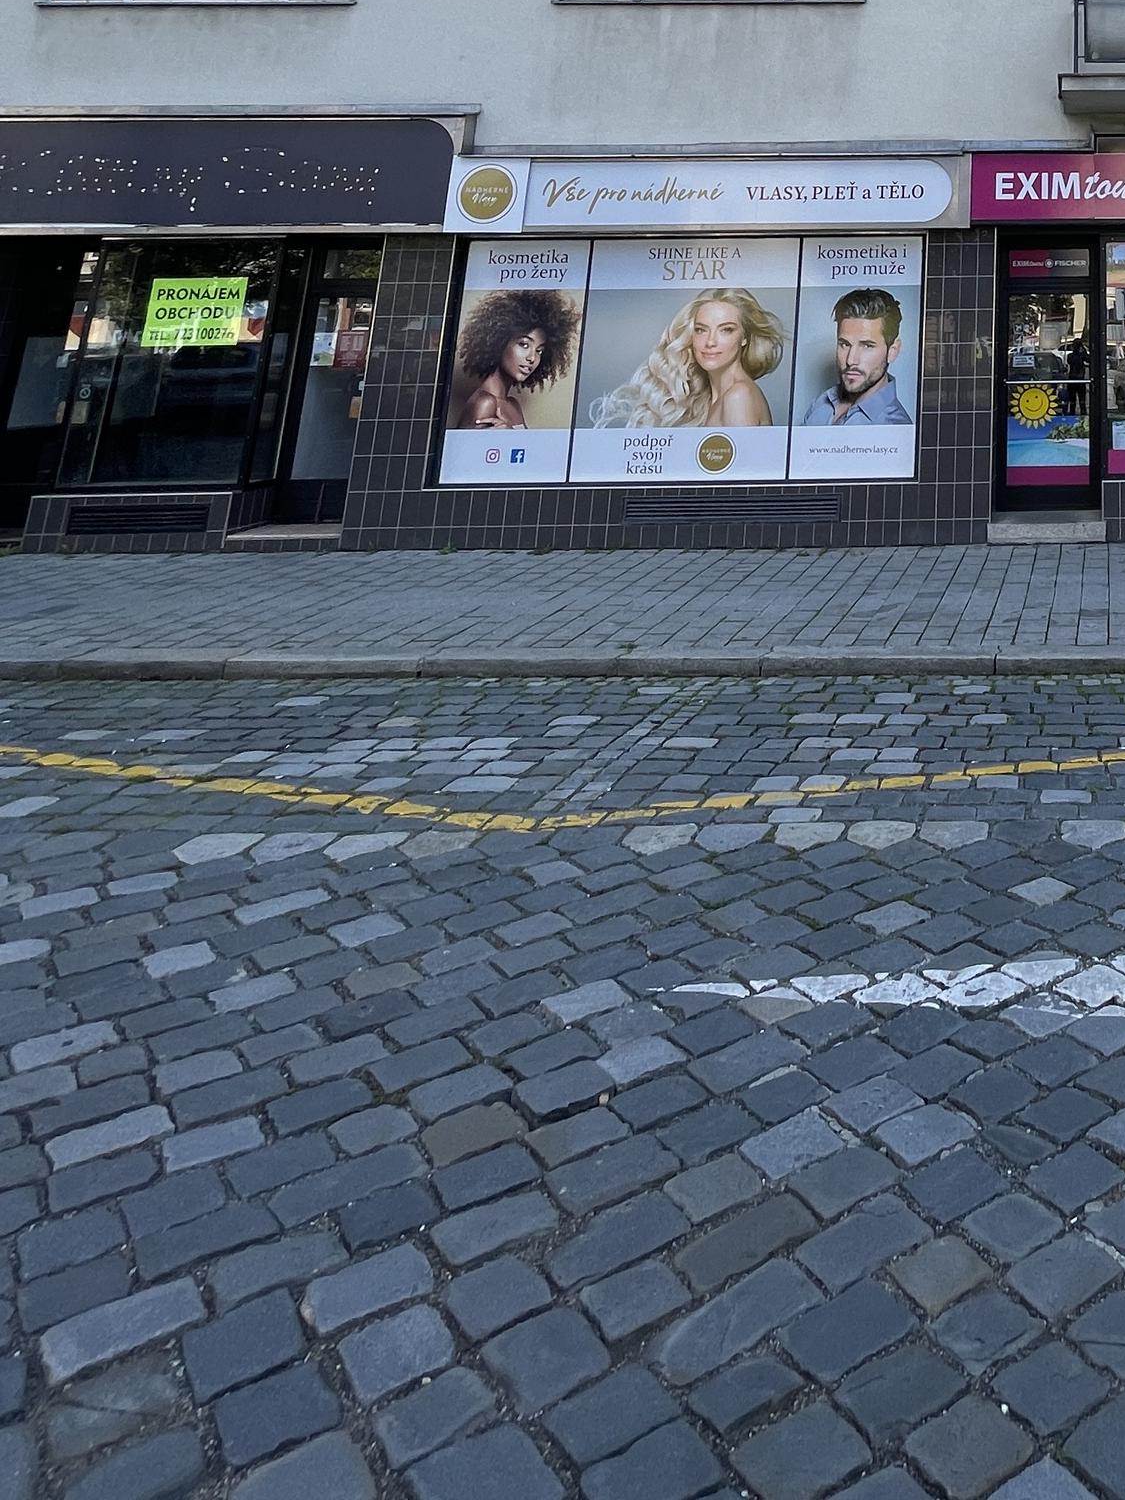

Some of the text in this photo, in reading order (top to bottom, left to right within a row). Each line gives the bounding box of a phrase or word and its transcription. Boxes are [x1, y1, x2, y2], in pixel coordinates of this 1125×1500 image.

[543, 176, 925, 215] Vše pro nádherné VLASY, PLEŤ a TĚLO
[488, 250, 569, 265] kosmetika
[648, 246, 742, 260] SHINE LIKE A
[817, 244, 908, 260] kosmetika i
[500, 265, 568, 283] pro ženy
[662, 260, 727, 280] STAR
[831, 261, 906, 280] pro muže
[157, 284, 240, 300] PRONÁJEM
[155, 307, 235, 320] OBCHODU
[624, 434, 673, 450] podpoř
[632, 449, 663, 461] svoji
[626, 460, 663, 474] krásu
